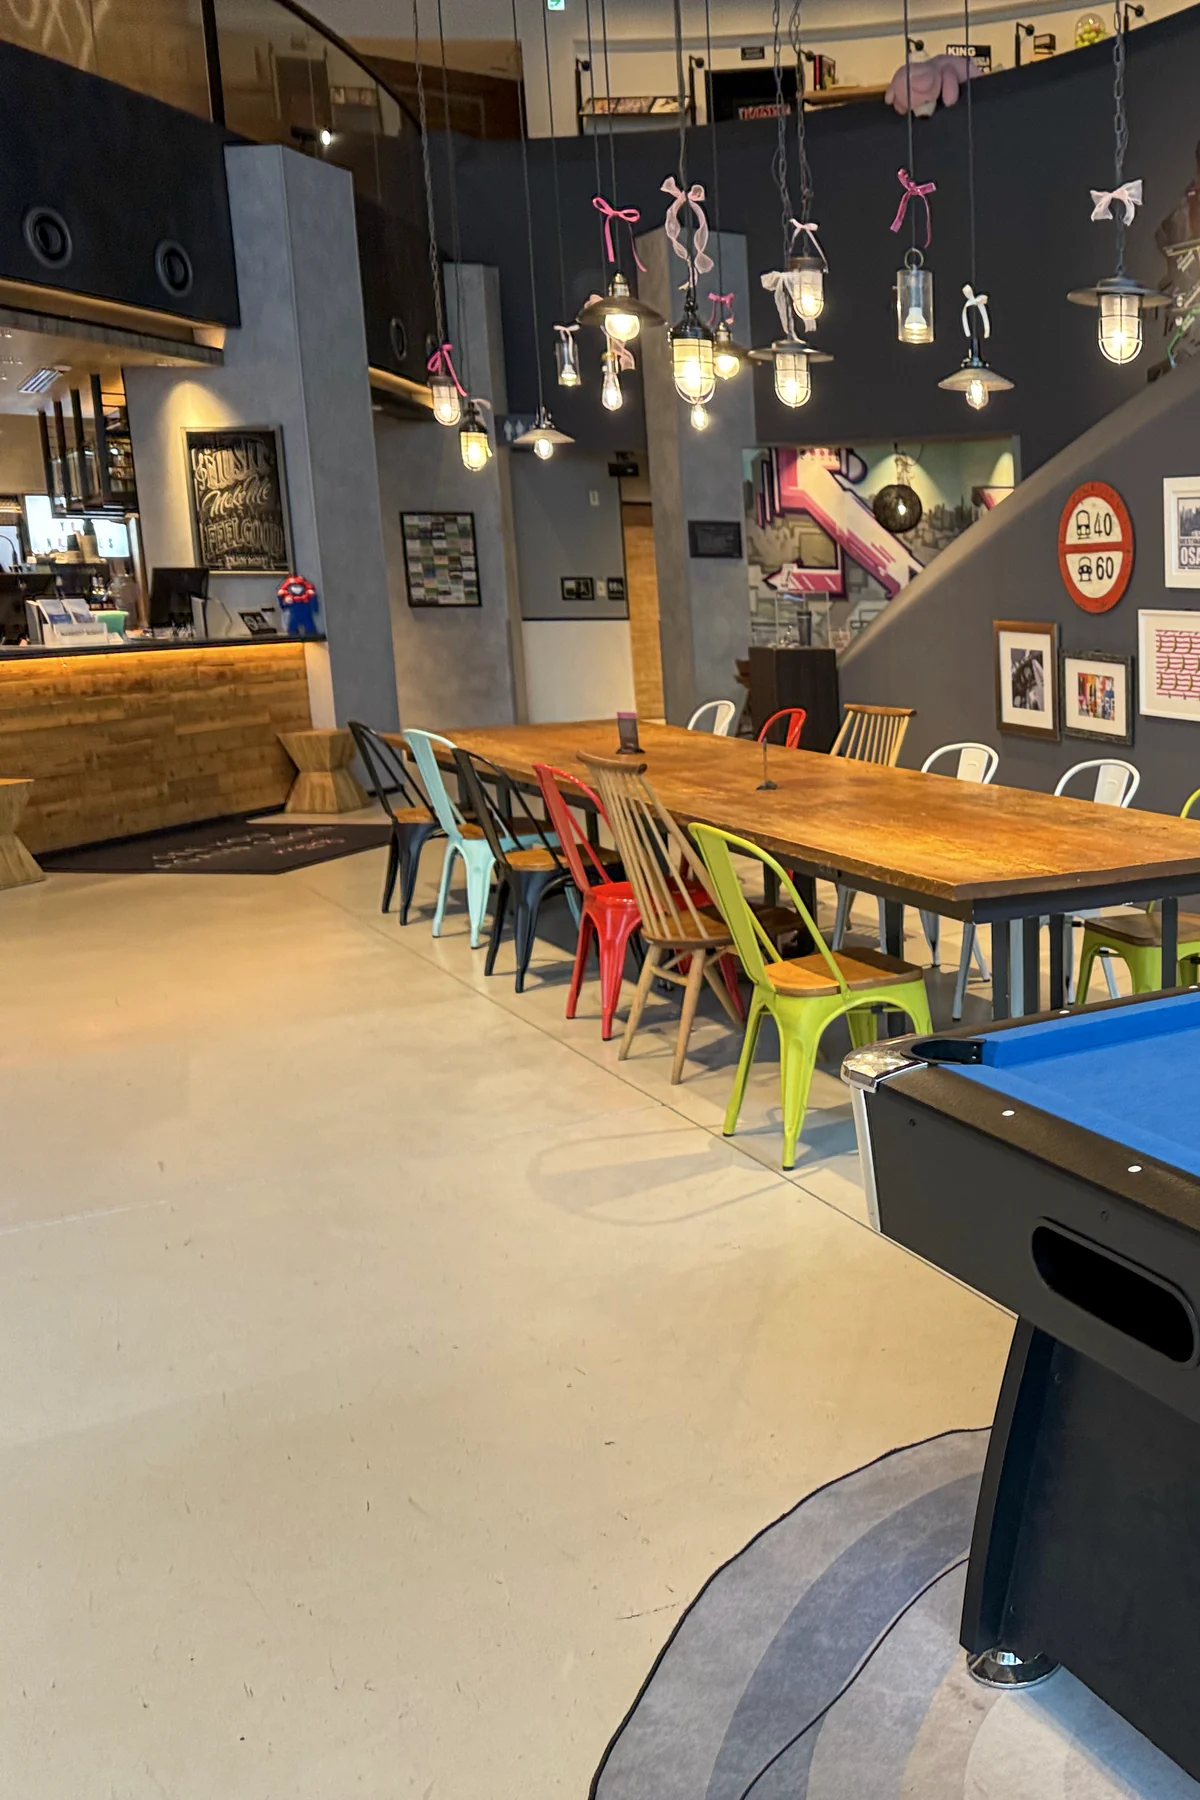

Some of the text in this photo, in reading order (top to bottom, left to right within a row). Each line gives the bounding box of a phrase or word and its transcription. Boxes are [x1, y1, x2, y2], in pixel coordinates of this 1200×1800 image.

[948, 46, 977, 57] KING
[1094, 511, 1112, 537] 40
[205, 518, 244, 559] FEEL
[1096, 556, 1114, 581] 60
